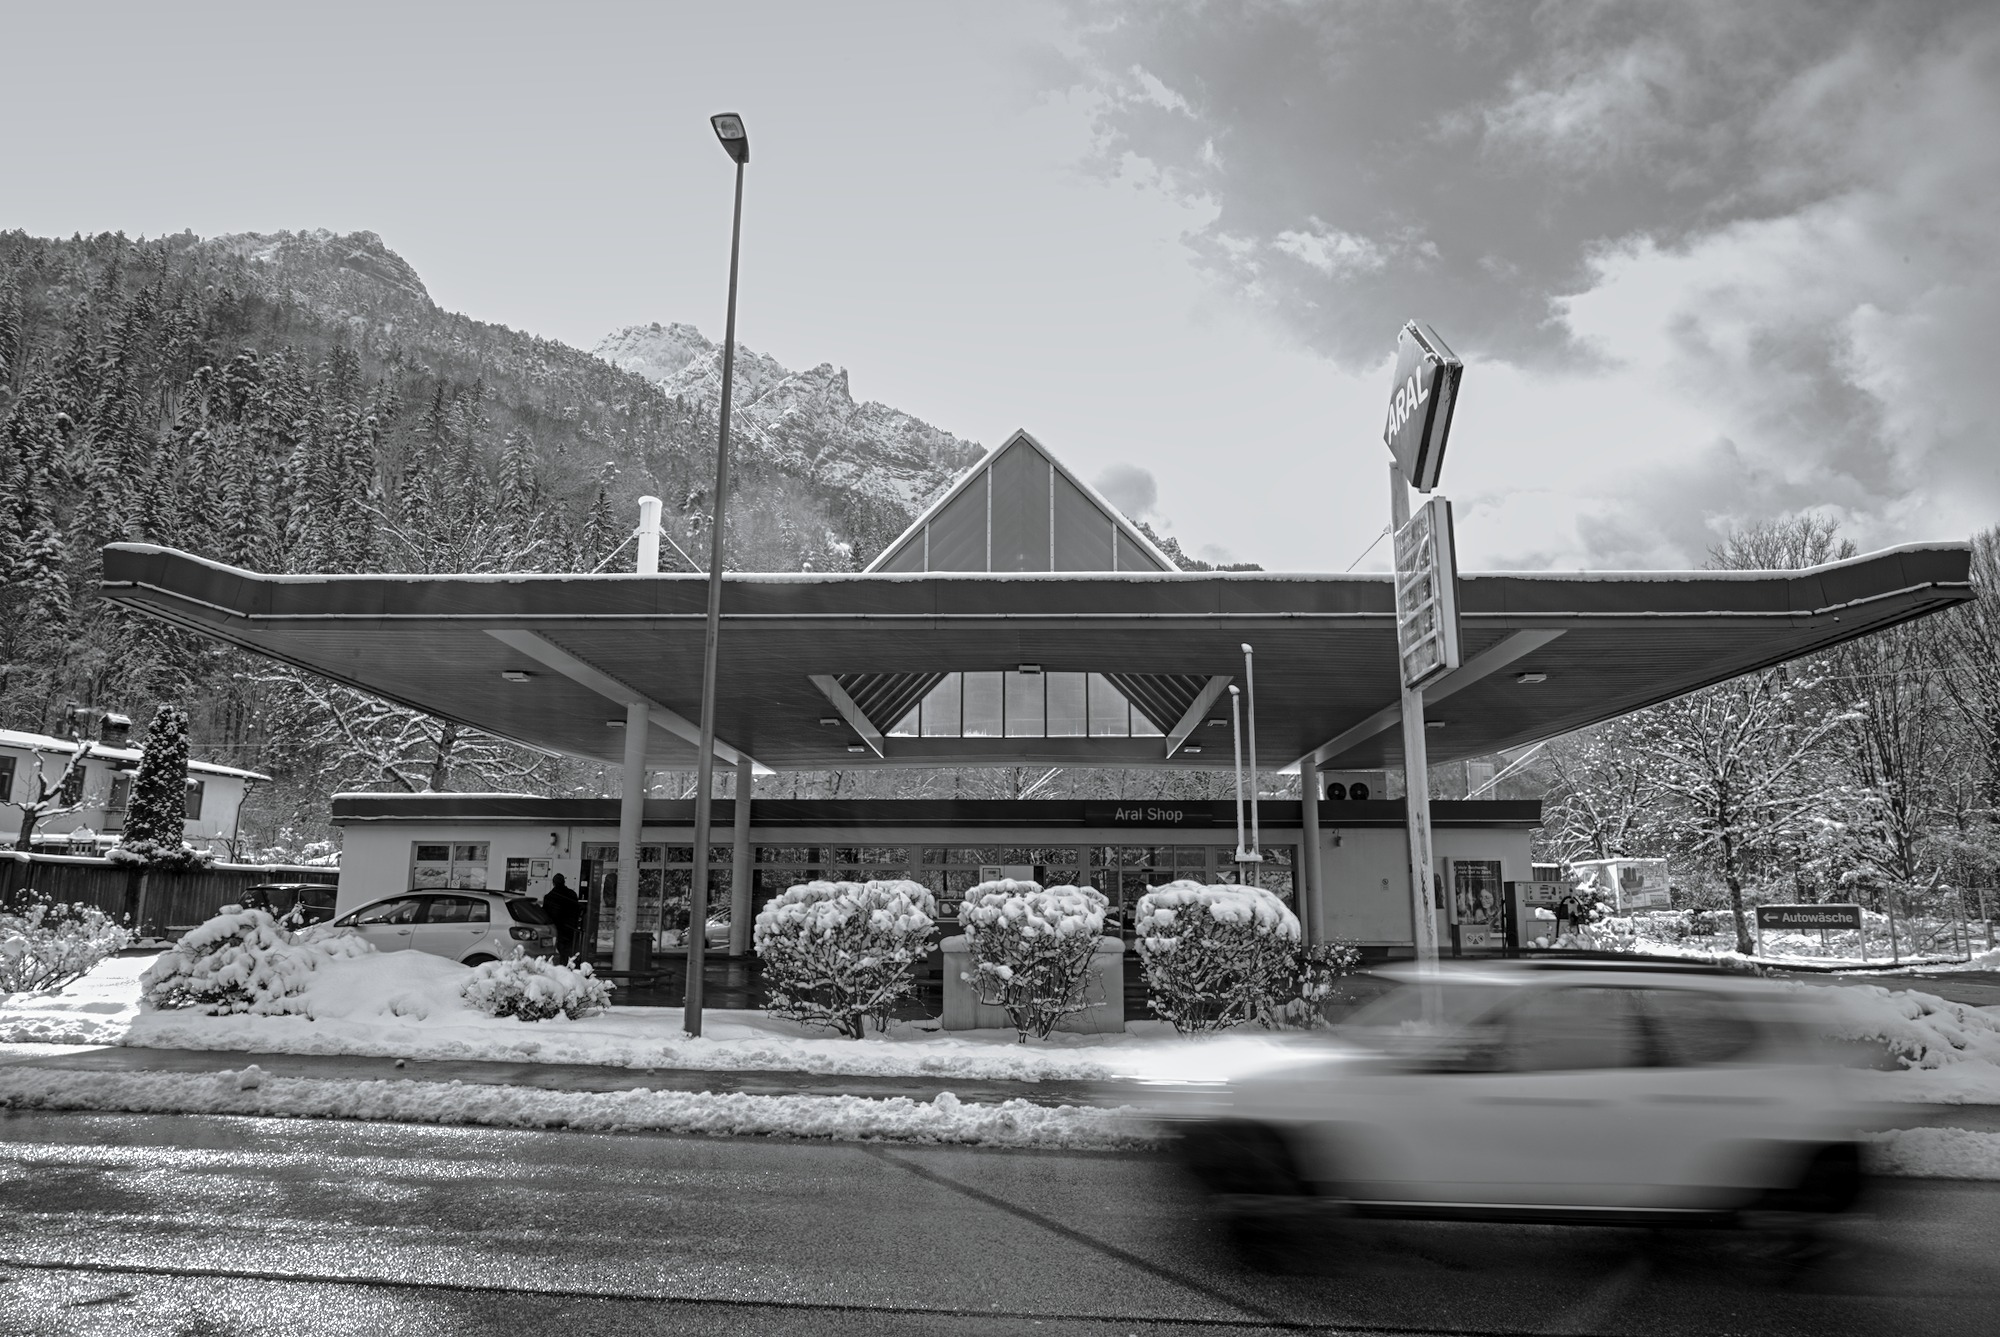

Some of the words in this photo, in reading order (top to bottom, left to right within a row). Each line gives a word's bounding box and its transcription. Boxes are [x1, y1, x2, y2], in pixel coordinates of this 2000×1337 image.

[1389, 366, 1428, 445] ARAL
[1115, 807, 1142, 820] Aral
[1147, 807, 1183, 823] Shop
[1782, 912, 1853, 922] Autowäsche
